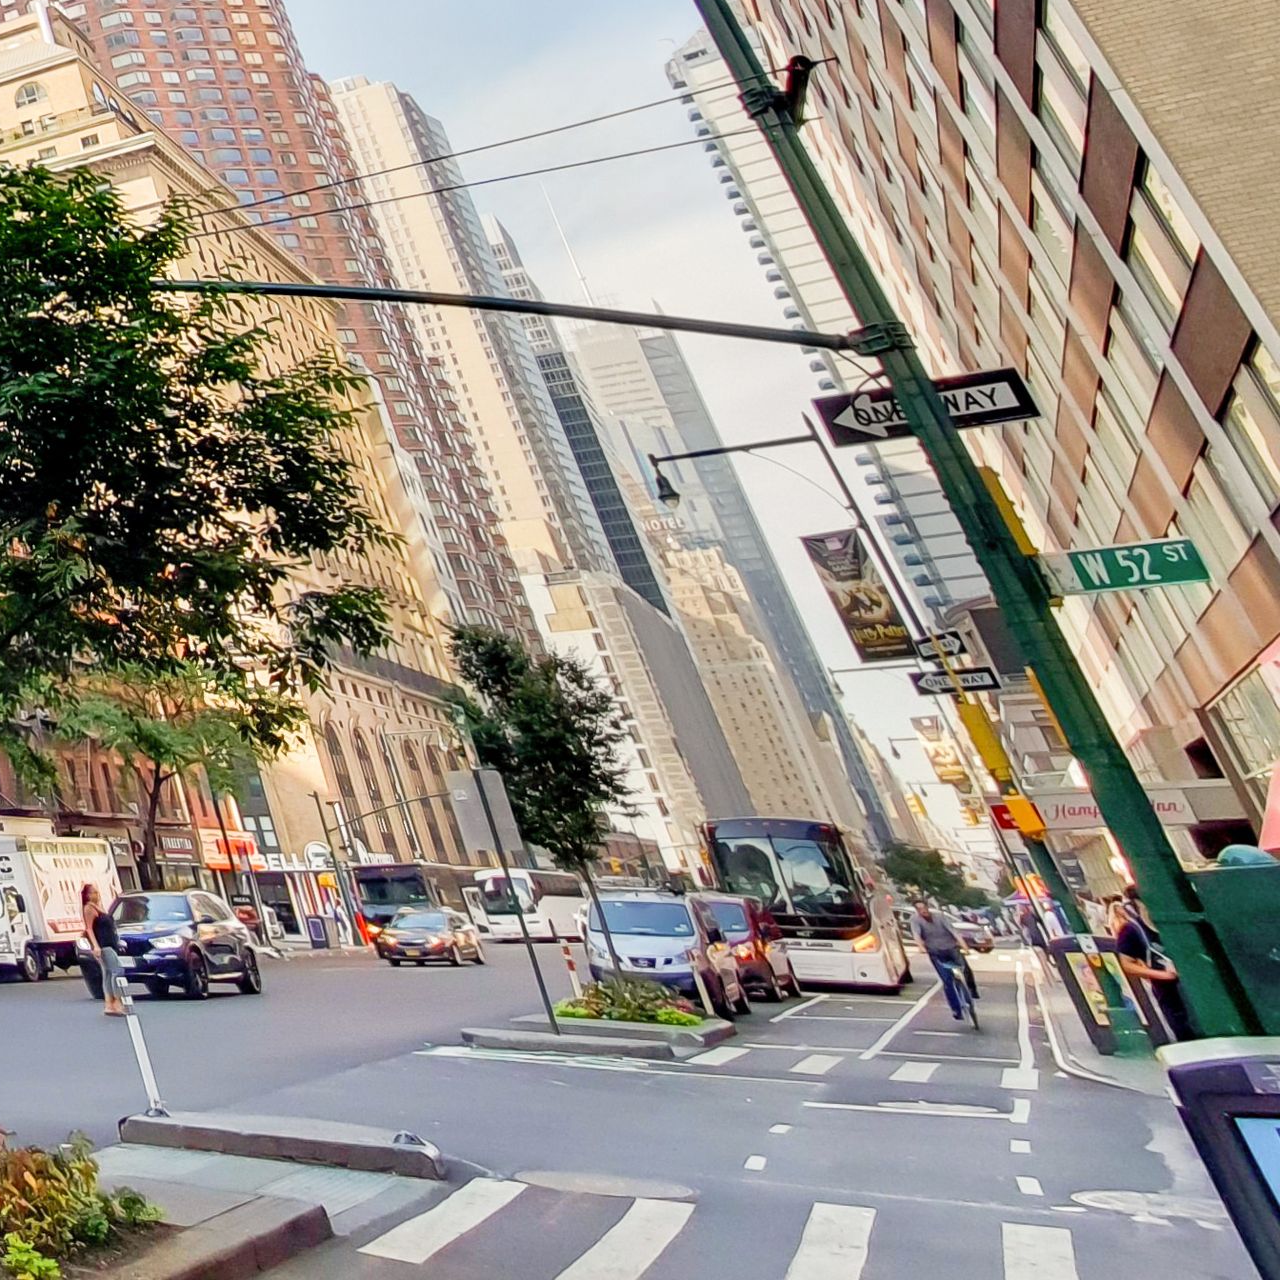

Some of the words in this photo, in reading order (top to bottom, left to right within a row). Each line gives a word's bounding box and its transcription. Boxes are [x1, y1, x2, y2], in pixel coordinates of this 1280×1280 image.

[1078, 553, 1111, 586] W
[1115, 548, 1162, 583] 52
[1162, 544, 1189, 562] ST
